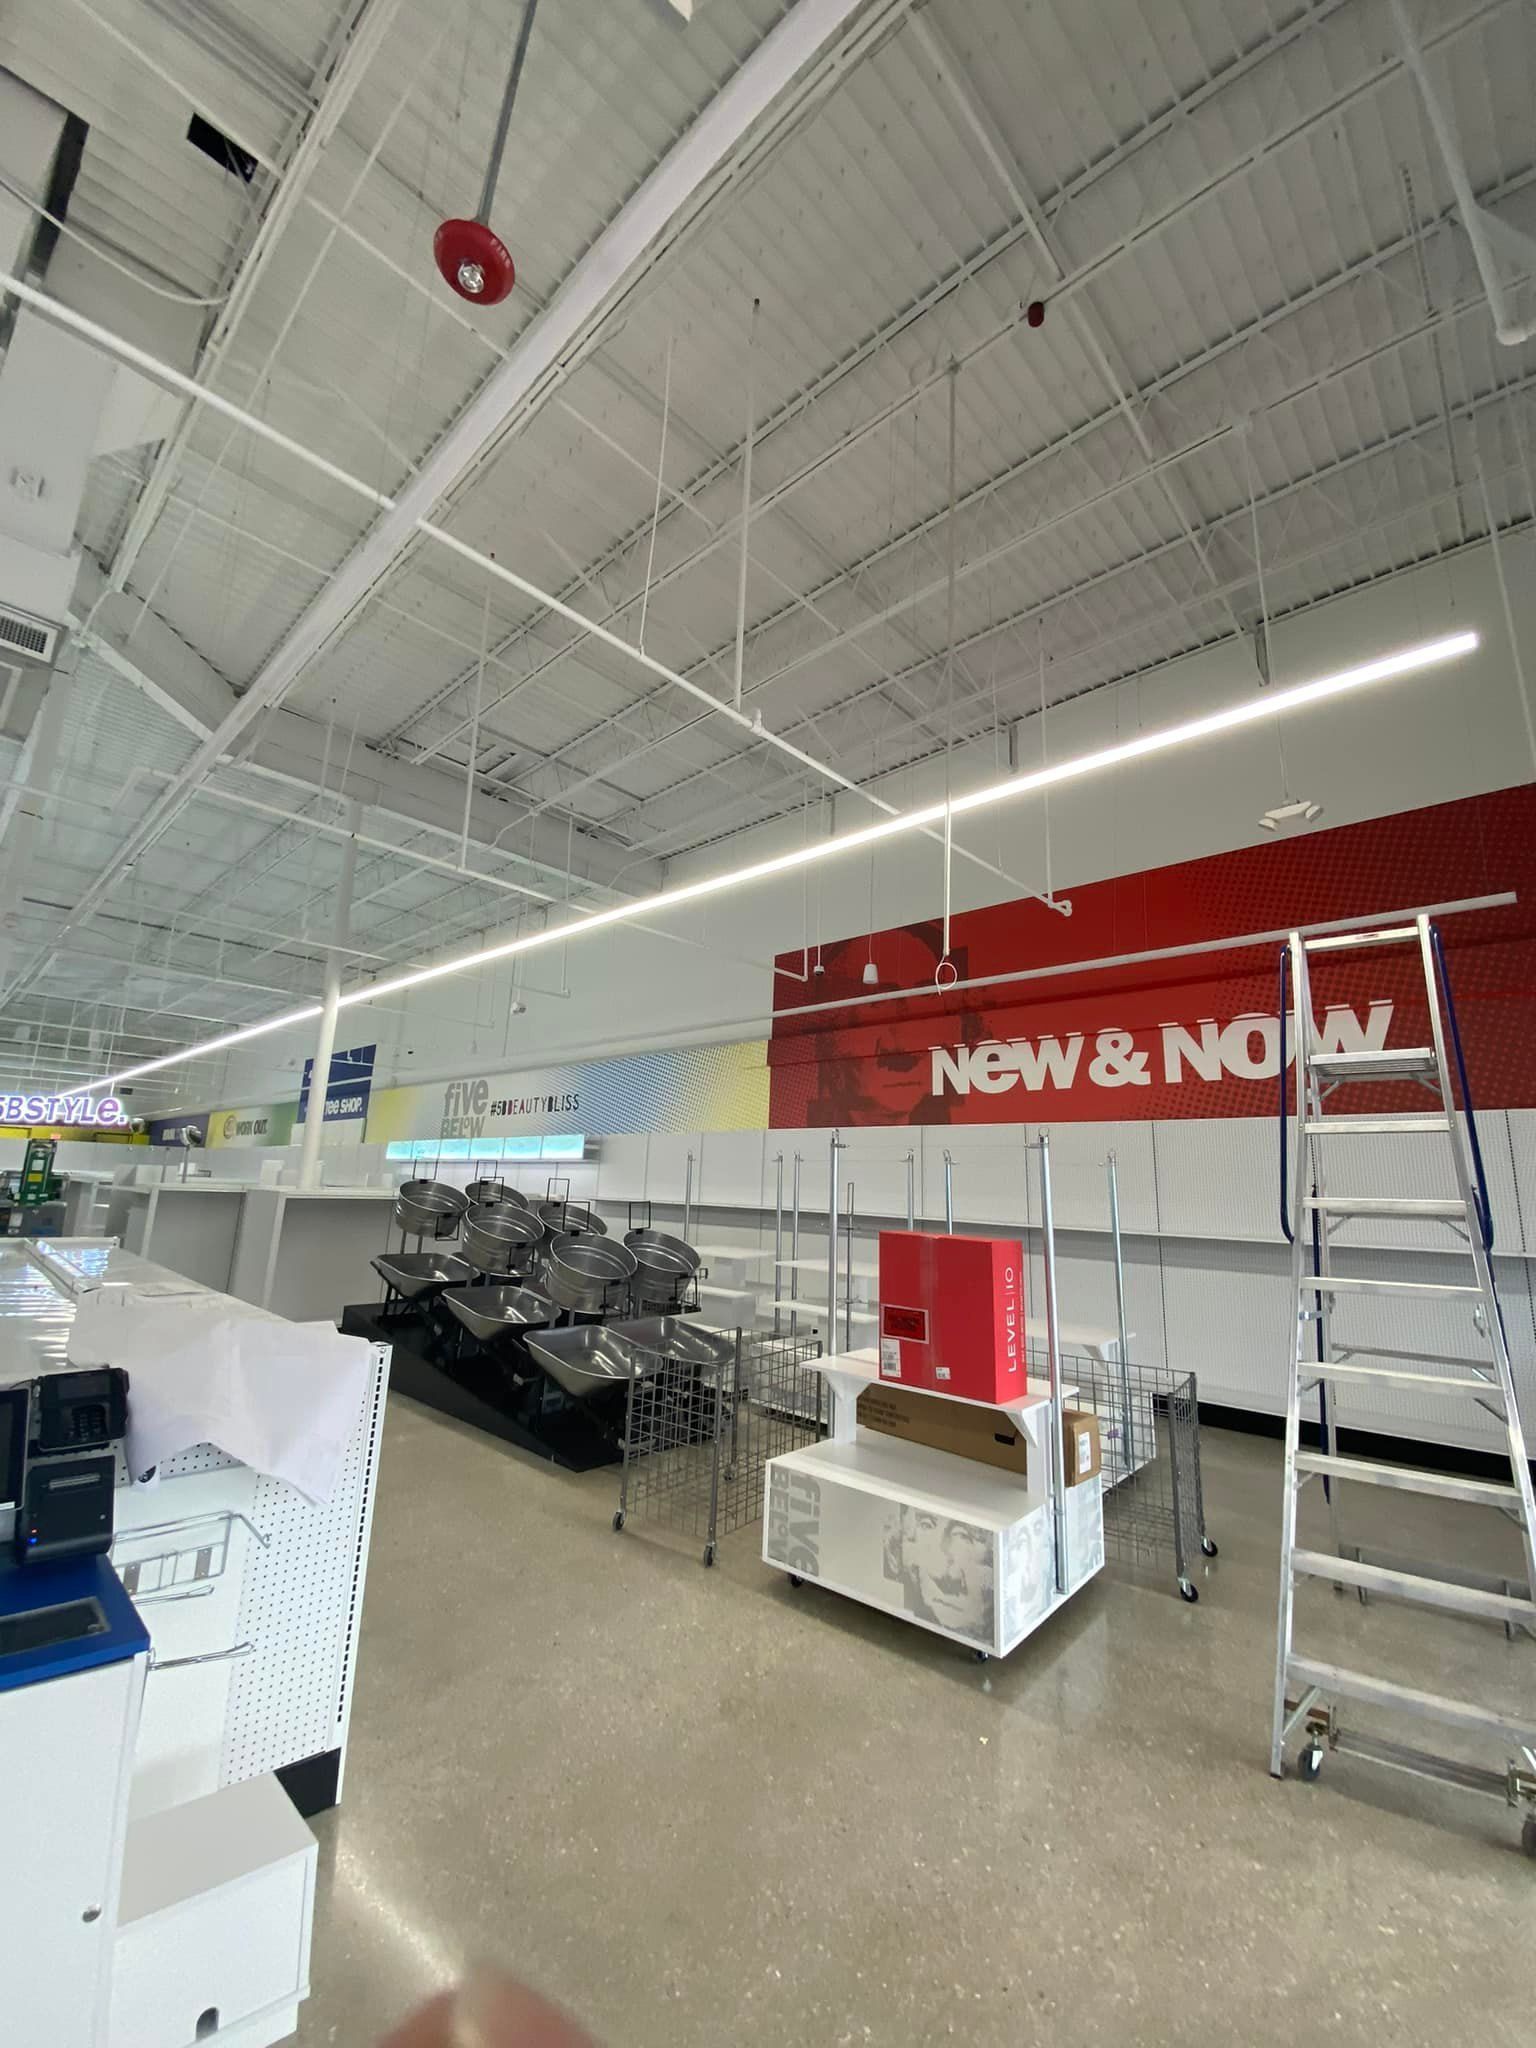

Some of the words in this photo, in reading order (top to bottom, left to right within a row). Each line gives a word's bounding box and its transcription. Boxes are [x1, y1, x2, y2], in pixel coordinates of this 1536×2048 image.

[1089, 1027, 1151, 1087] &
[444, 1079, 488, 1117] five
[1006, 1298, 1017, 1373] LEVEL
